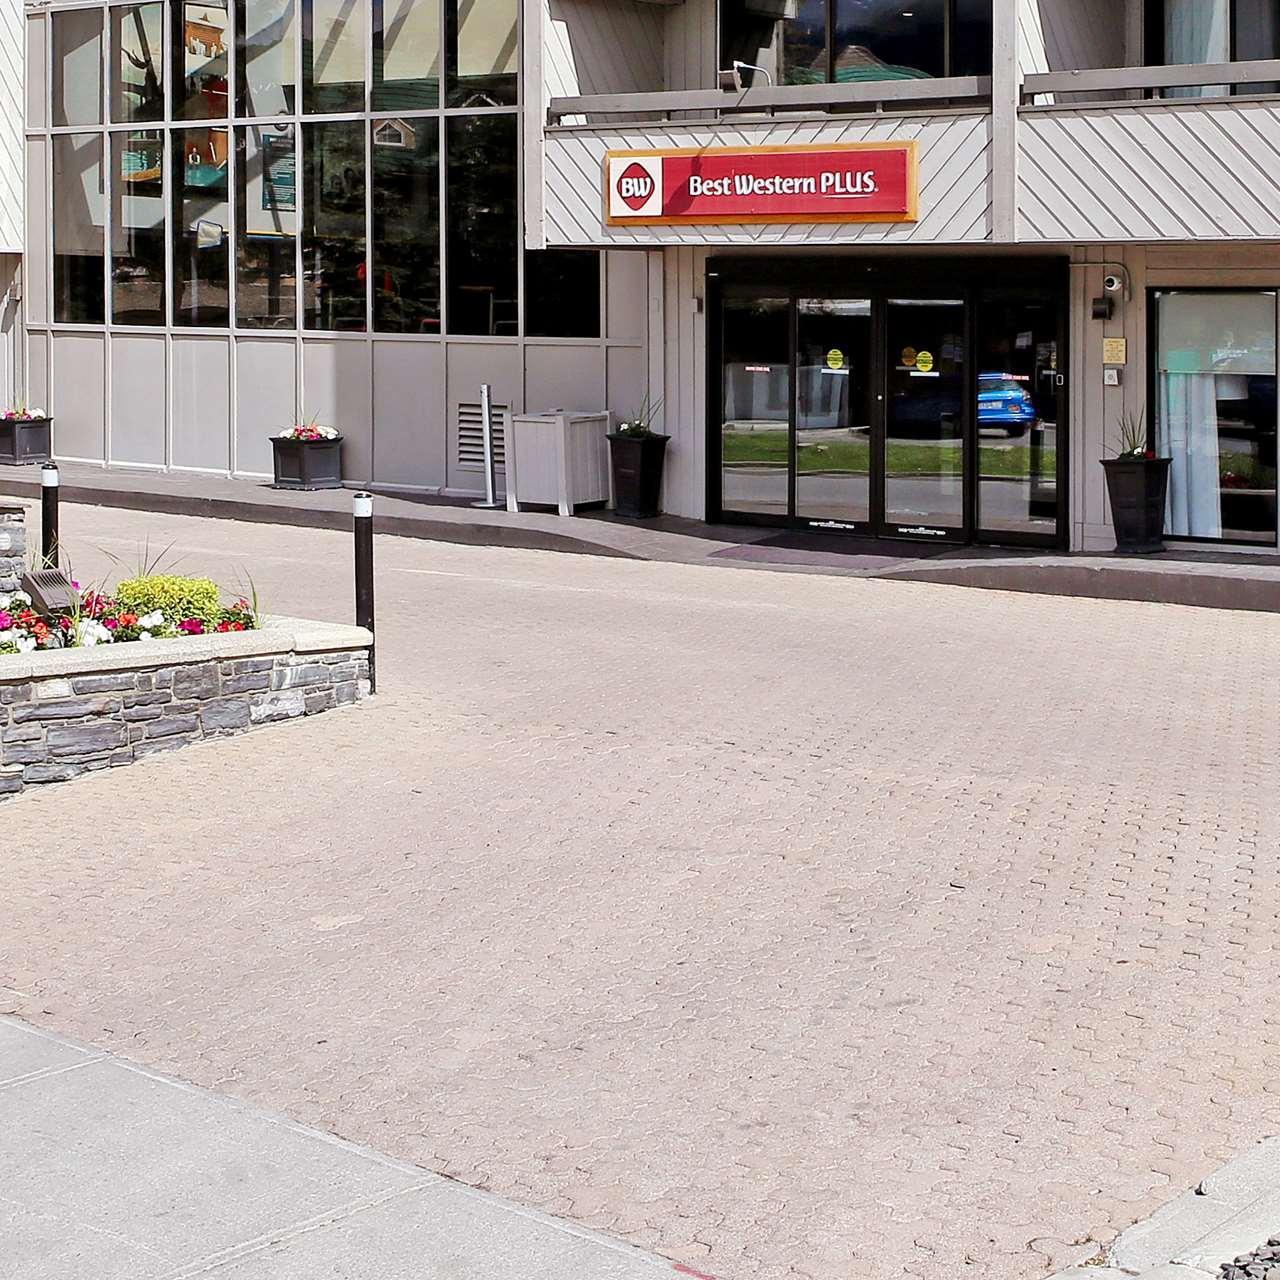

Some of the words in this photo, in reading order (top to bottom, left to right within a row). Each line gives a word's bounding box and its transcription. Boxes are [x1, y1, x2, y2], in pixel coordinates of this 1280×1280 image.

[621, 177, 651, 199] BW
[689, 176, 731, 196] Best
[734, 174, 816, 195] Western
[820, 171, 876, 193] PLUS
